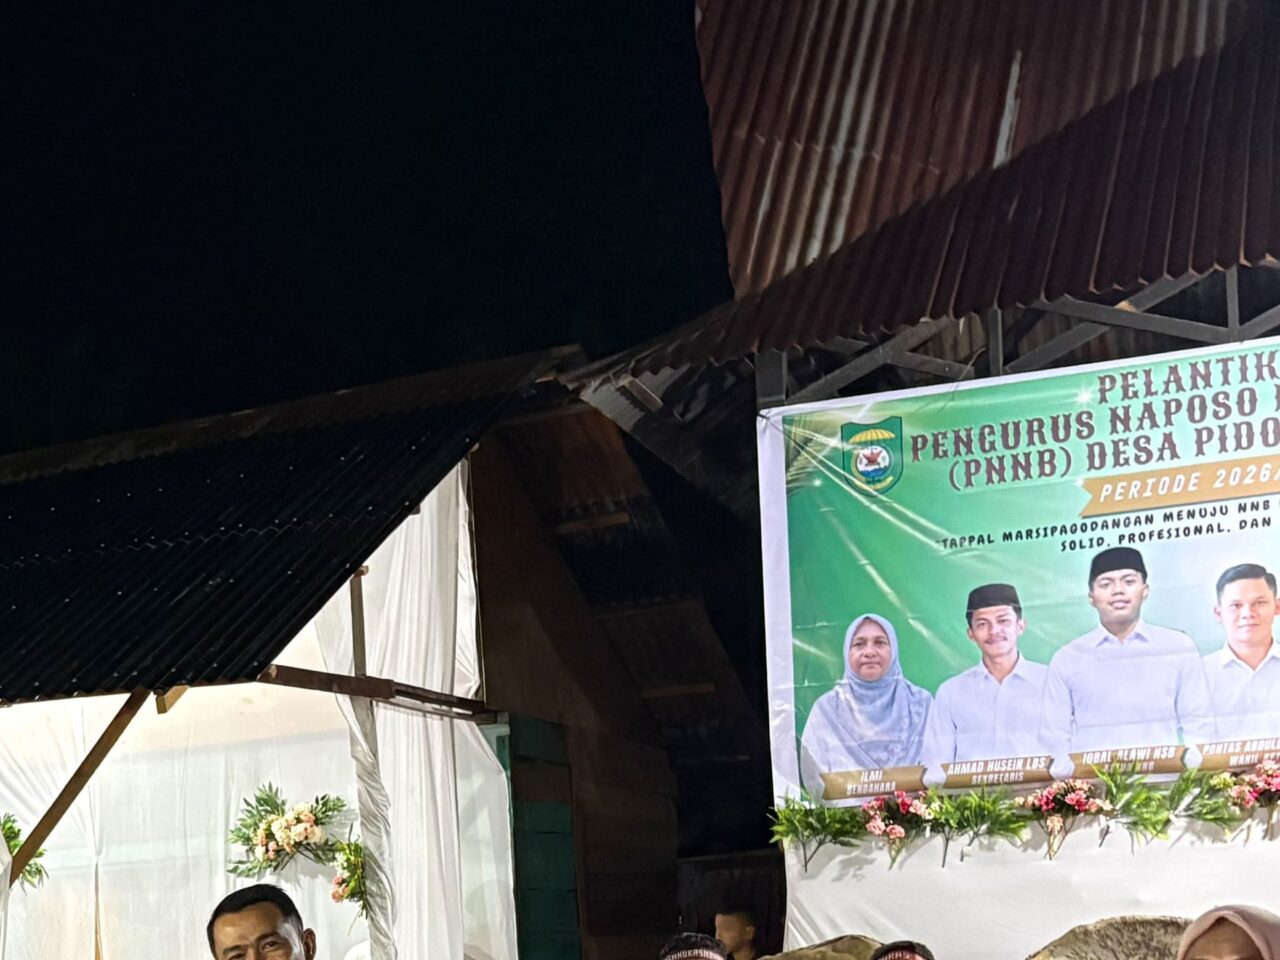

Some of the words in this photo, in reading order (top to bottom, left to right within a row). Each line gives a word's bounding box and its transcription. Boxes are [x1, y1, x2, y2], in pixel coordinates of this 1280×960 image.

[911, 410, 1095, 463] PENGURUS
[1109, 387, 1258, 435] NAPOSO
[949, 446, 1072, 491] (PNNB)
[1086, 431, 1180, 471] DESA
[1194, 417, 1280, 457] PIDO
[1100, 472, 1201, 503] PERIODE
[1163, 505, 1229, 522] MENUJU
[1238, 500, 1271, 513] NNB
[1239, 517, 1271, 530] DAN
[947, 761, 985, 775] AHMAD
[987, 758, 1025, 772] HUSEIN
